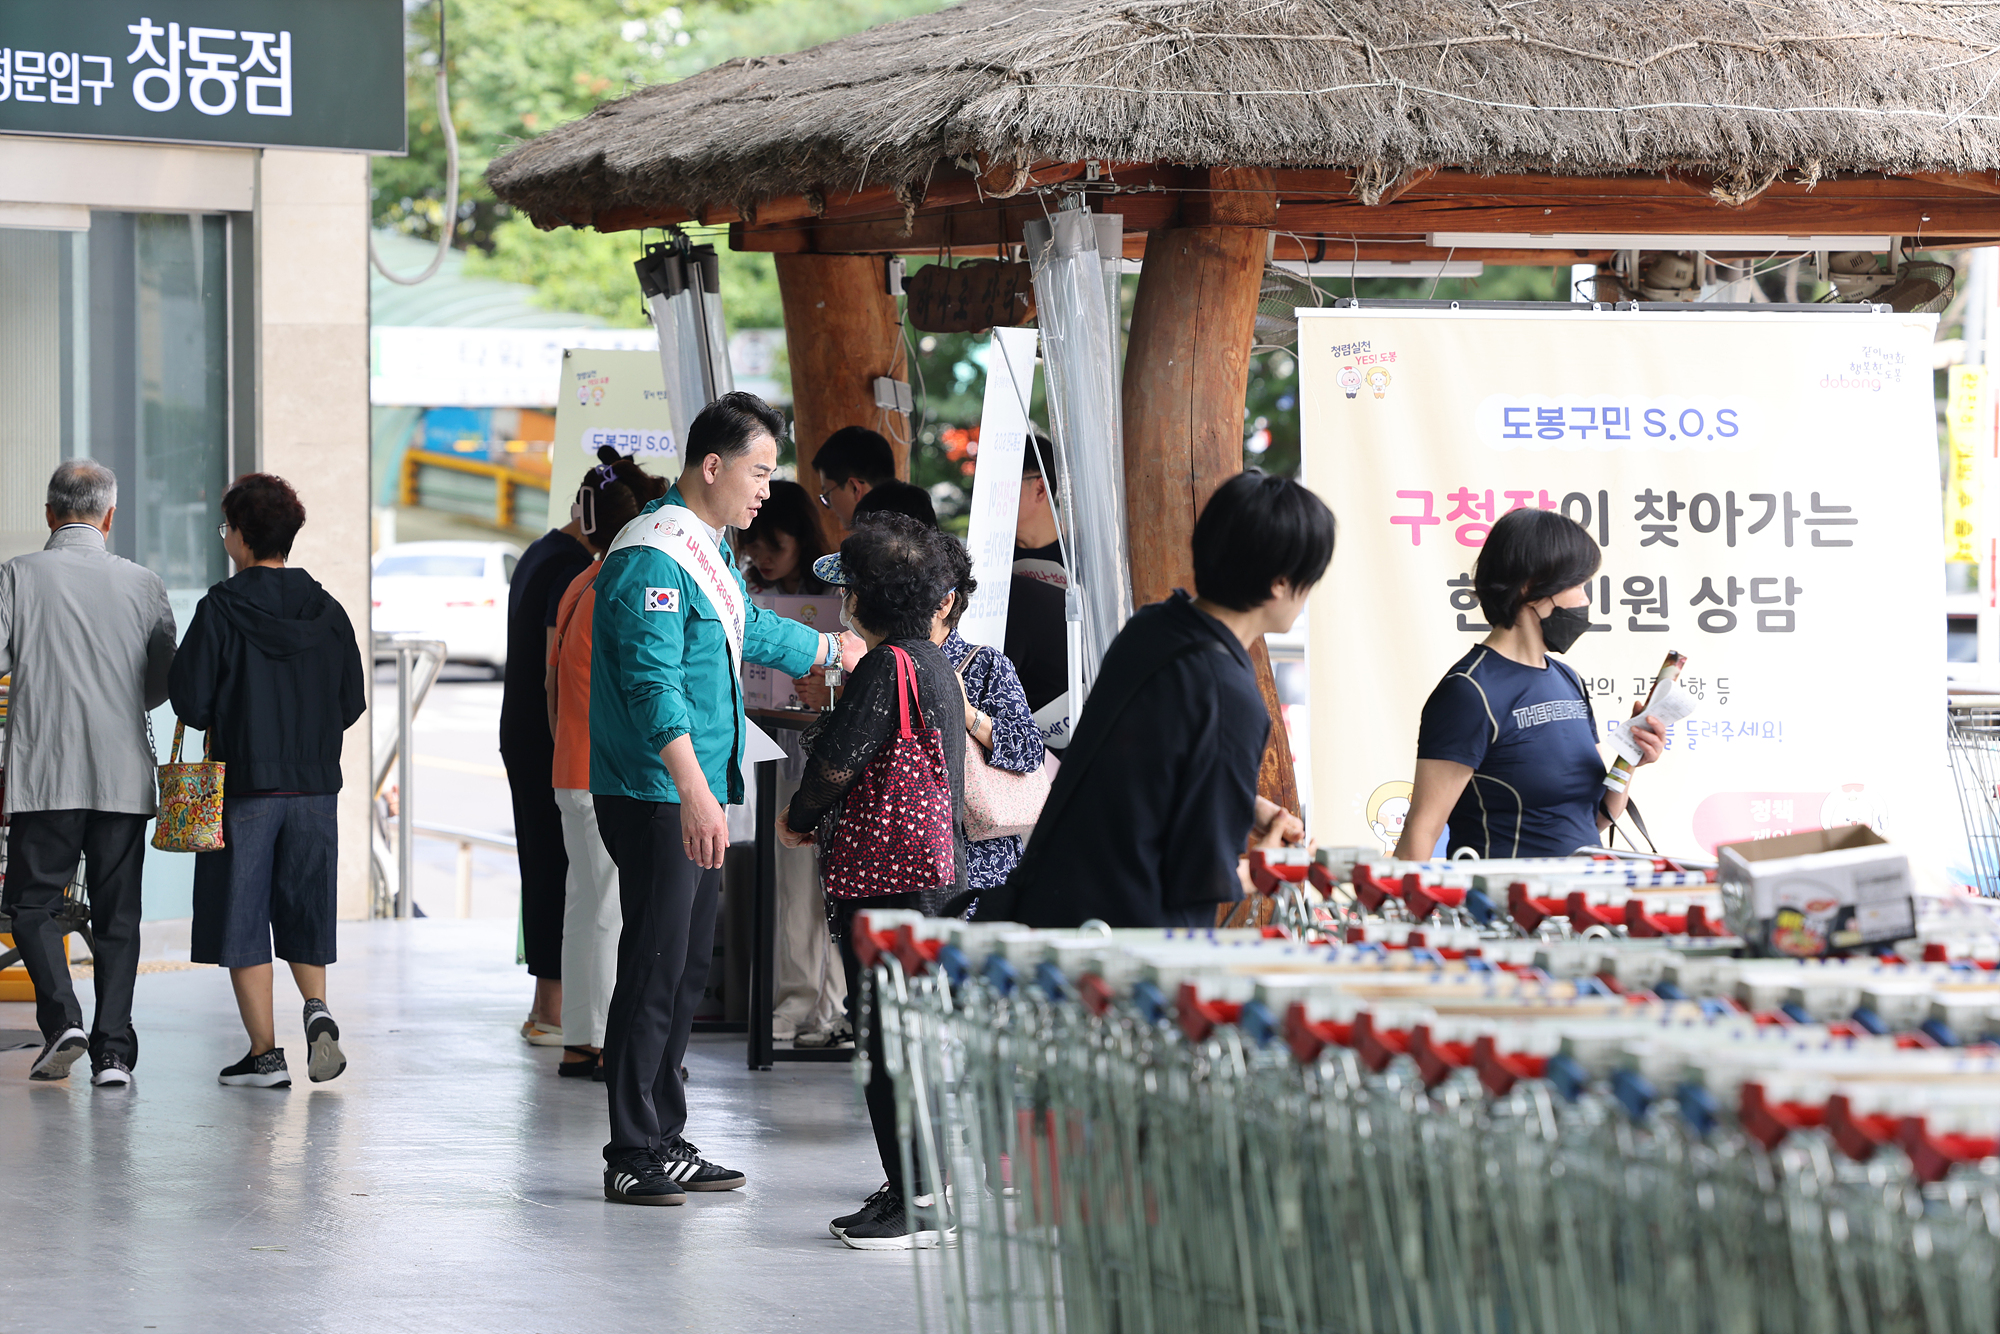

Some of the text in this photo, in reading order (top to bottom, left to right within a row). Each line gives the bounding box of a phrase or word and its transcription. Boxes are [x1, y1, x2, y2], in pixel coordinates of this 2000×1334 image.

[127, 17, 292, 117] 창동점
[1331, 341, 1371, 358] 청렴실천
[1355, 351, 1397, 365] YES! 도봉
[1862, 346, 1882, 358] 같이
[1819, 374, 1881, 392] dobong
[1850, 362, 1902, 382] 행복한 도봉
[1502, 406, 1740, 441] 도봉구민 S.O.S
[646, 436, 678, 453] S.O.
[1634, 487, 1859, 549] 찾아가는
[1690, 575, 1804, 633] 상담
[1717, 678, 1730, 705] 등
[1686, 720, 1783, 751] 들려주세요!
[1749, 798, 1794, 823] 정책
